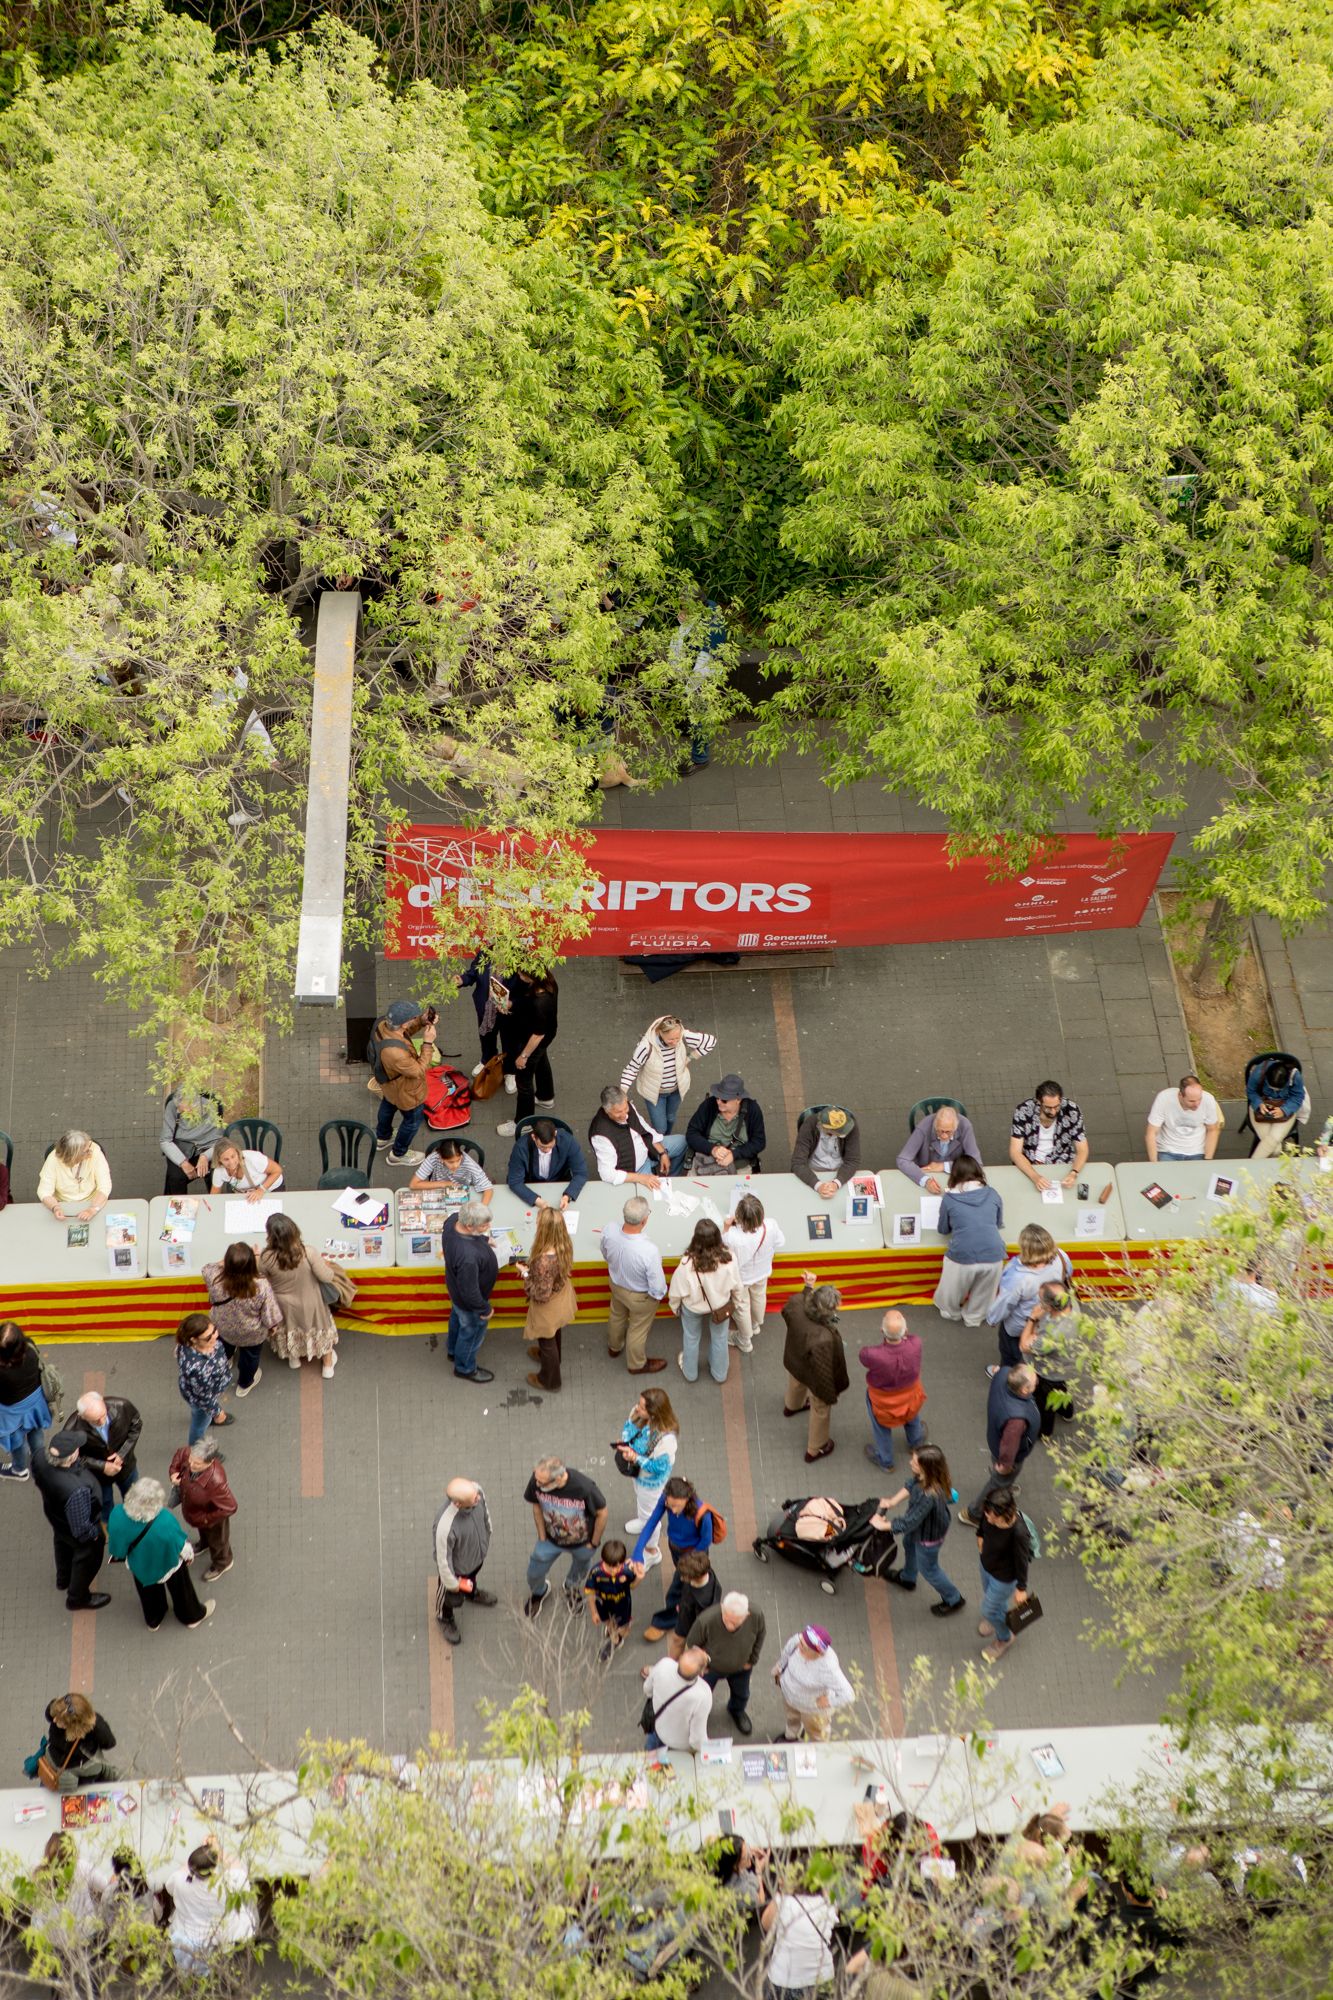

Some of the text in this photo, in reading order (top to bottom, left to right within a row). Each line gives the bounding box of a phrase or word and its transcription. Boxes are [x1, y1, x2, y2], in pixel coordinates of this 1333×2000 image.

[630, 933, 700, 941] Fundació
[764, 933, 828, 941] Generalitat
[777, 938, 838, 947] Catalunya
